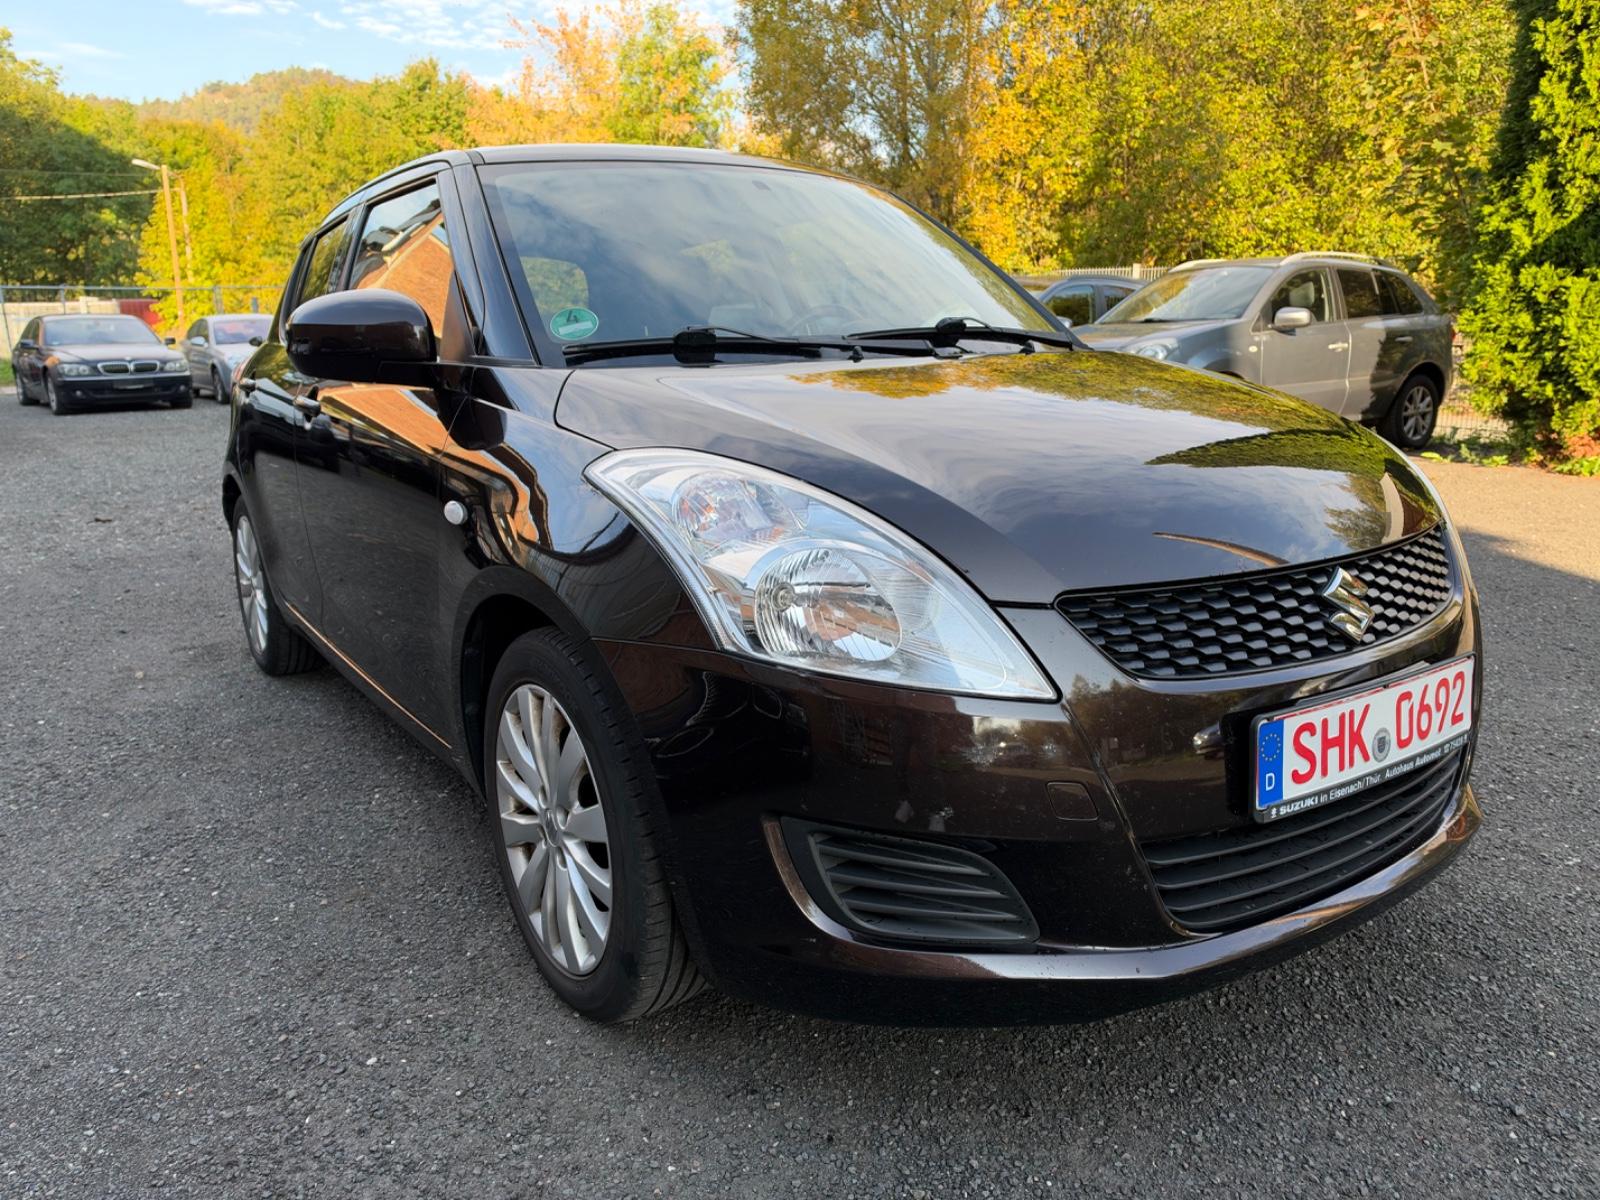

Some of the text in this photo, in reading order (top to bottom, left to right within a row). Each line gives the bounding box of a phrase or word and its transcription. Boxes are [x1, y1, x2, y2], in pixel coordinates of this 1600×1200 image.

[1291, 671, 1465, 785] SHK 0692
[1265, 772, 1275, 791] D
[1279, 796, 1319, 815] SUZUKI
[1320, 793, 1328, 803] in
[1385, 761, 1415, 778] Autohaus
